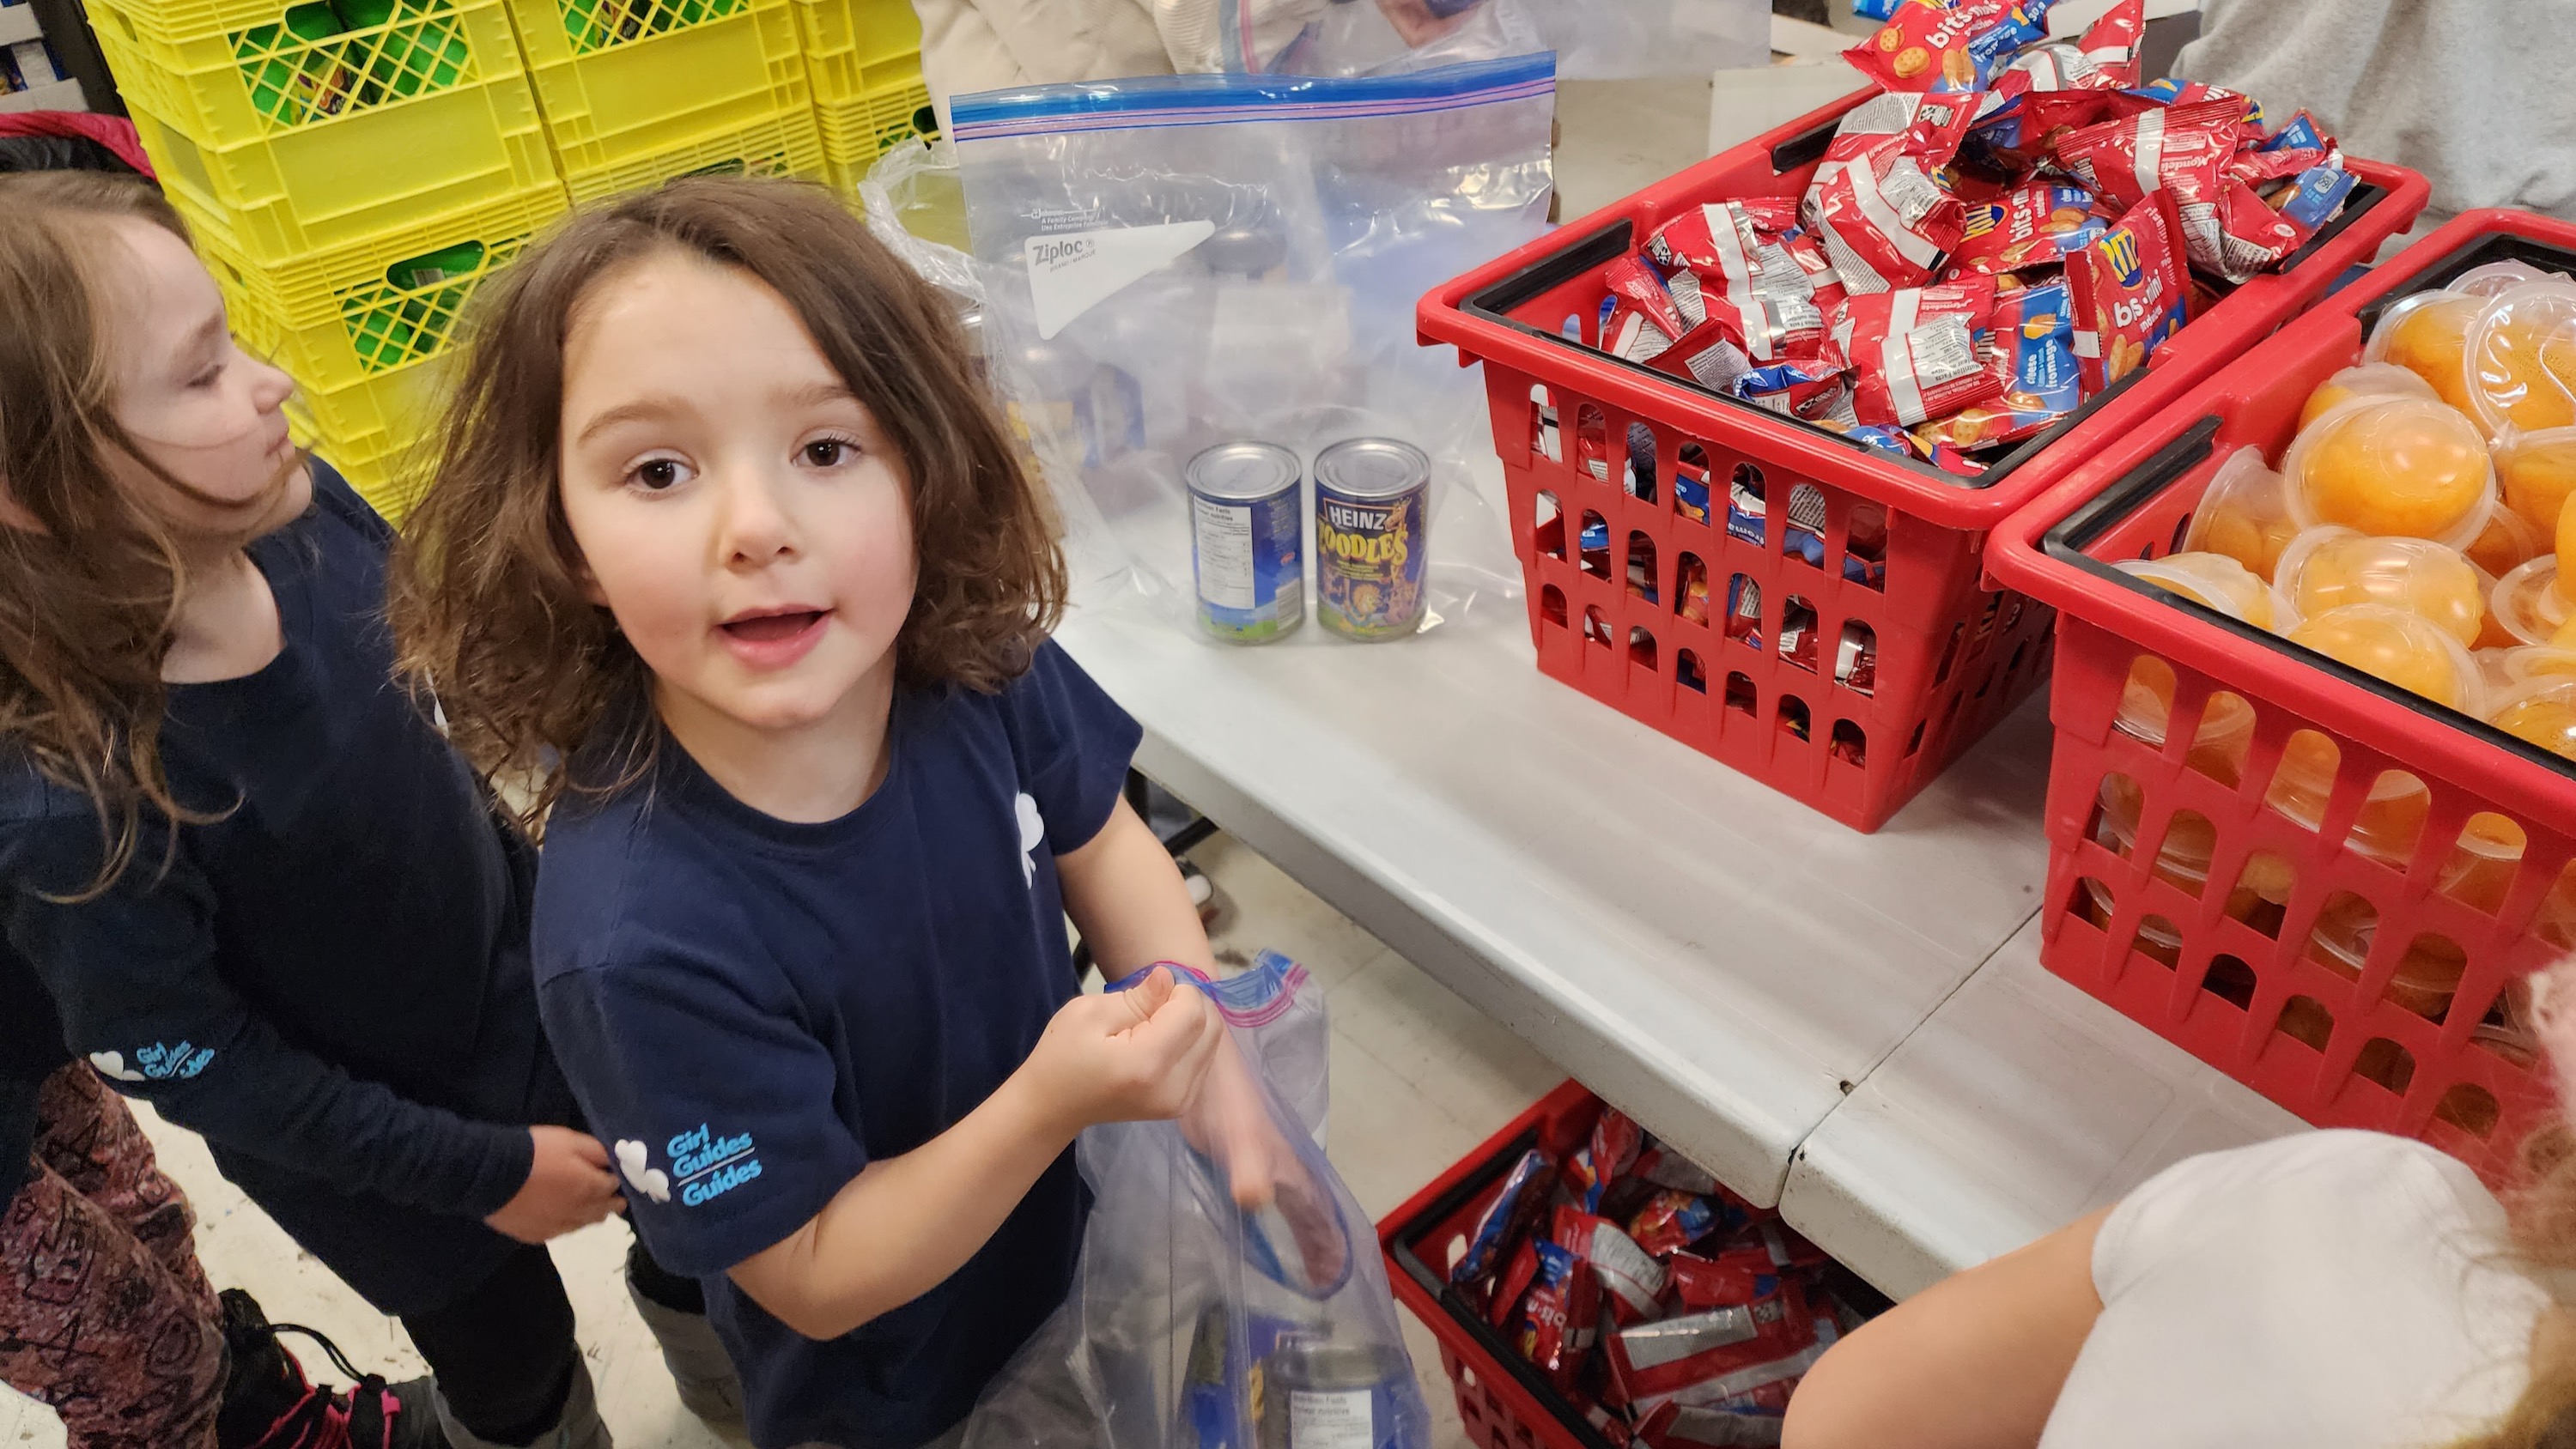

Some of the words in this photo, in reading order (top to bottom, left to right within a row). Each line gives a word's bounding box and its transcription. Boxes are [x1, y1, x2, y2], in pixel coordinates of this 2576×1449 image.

[1033, 240, 1084, 267] Ziploc
[2098, 227, 2142, 284] RITZ
[1935, 371, 1953, 382] Facts
[1329, 506, 1388, 530] HEINZ
[136, 1041, 167, 1064] Girl
[666, 1122, 710, 1158] Girl
[672, 1131, 753, 1178] Guides
[682, 1159, 762, 1207] Guides
